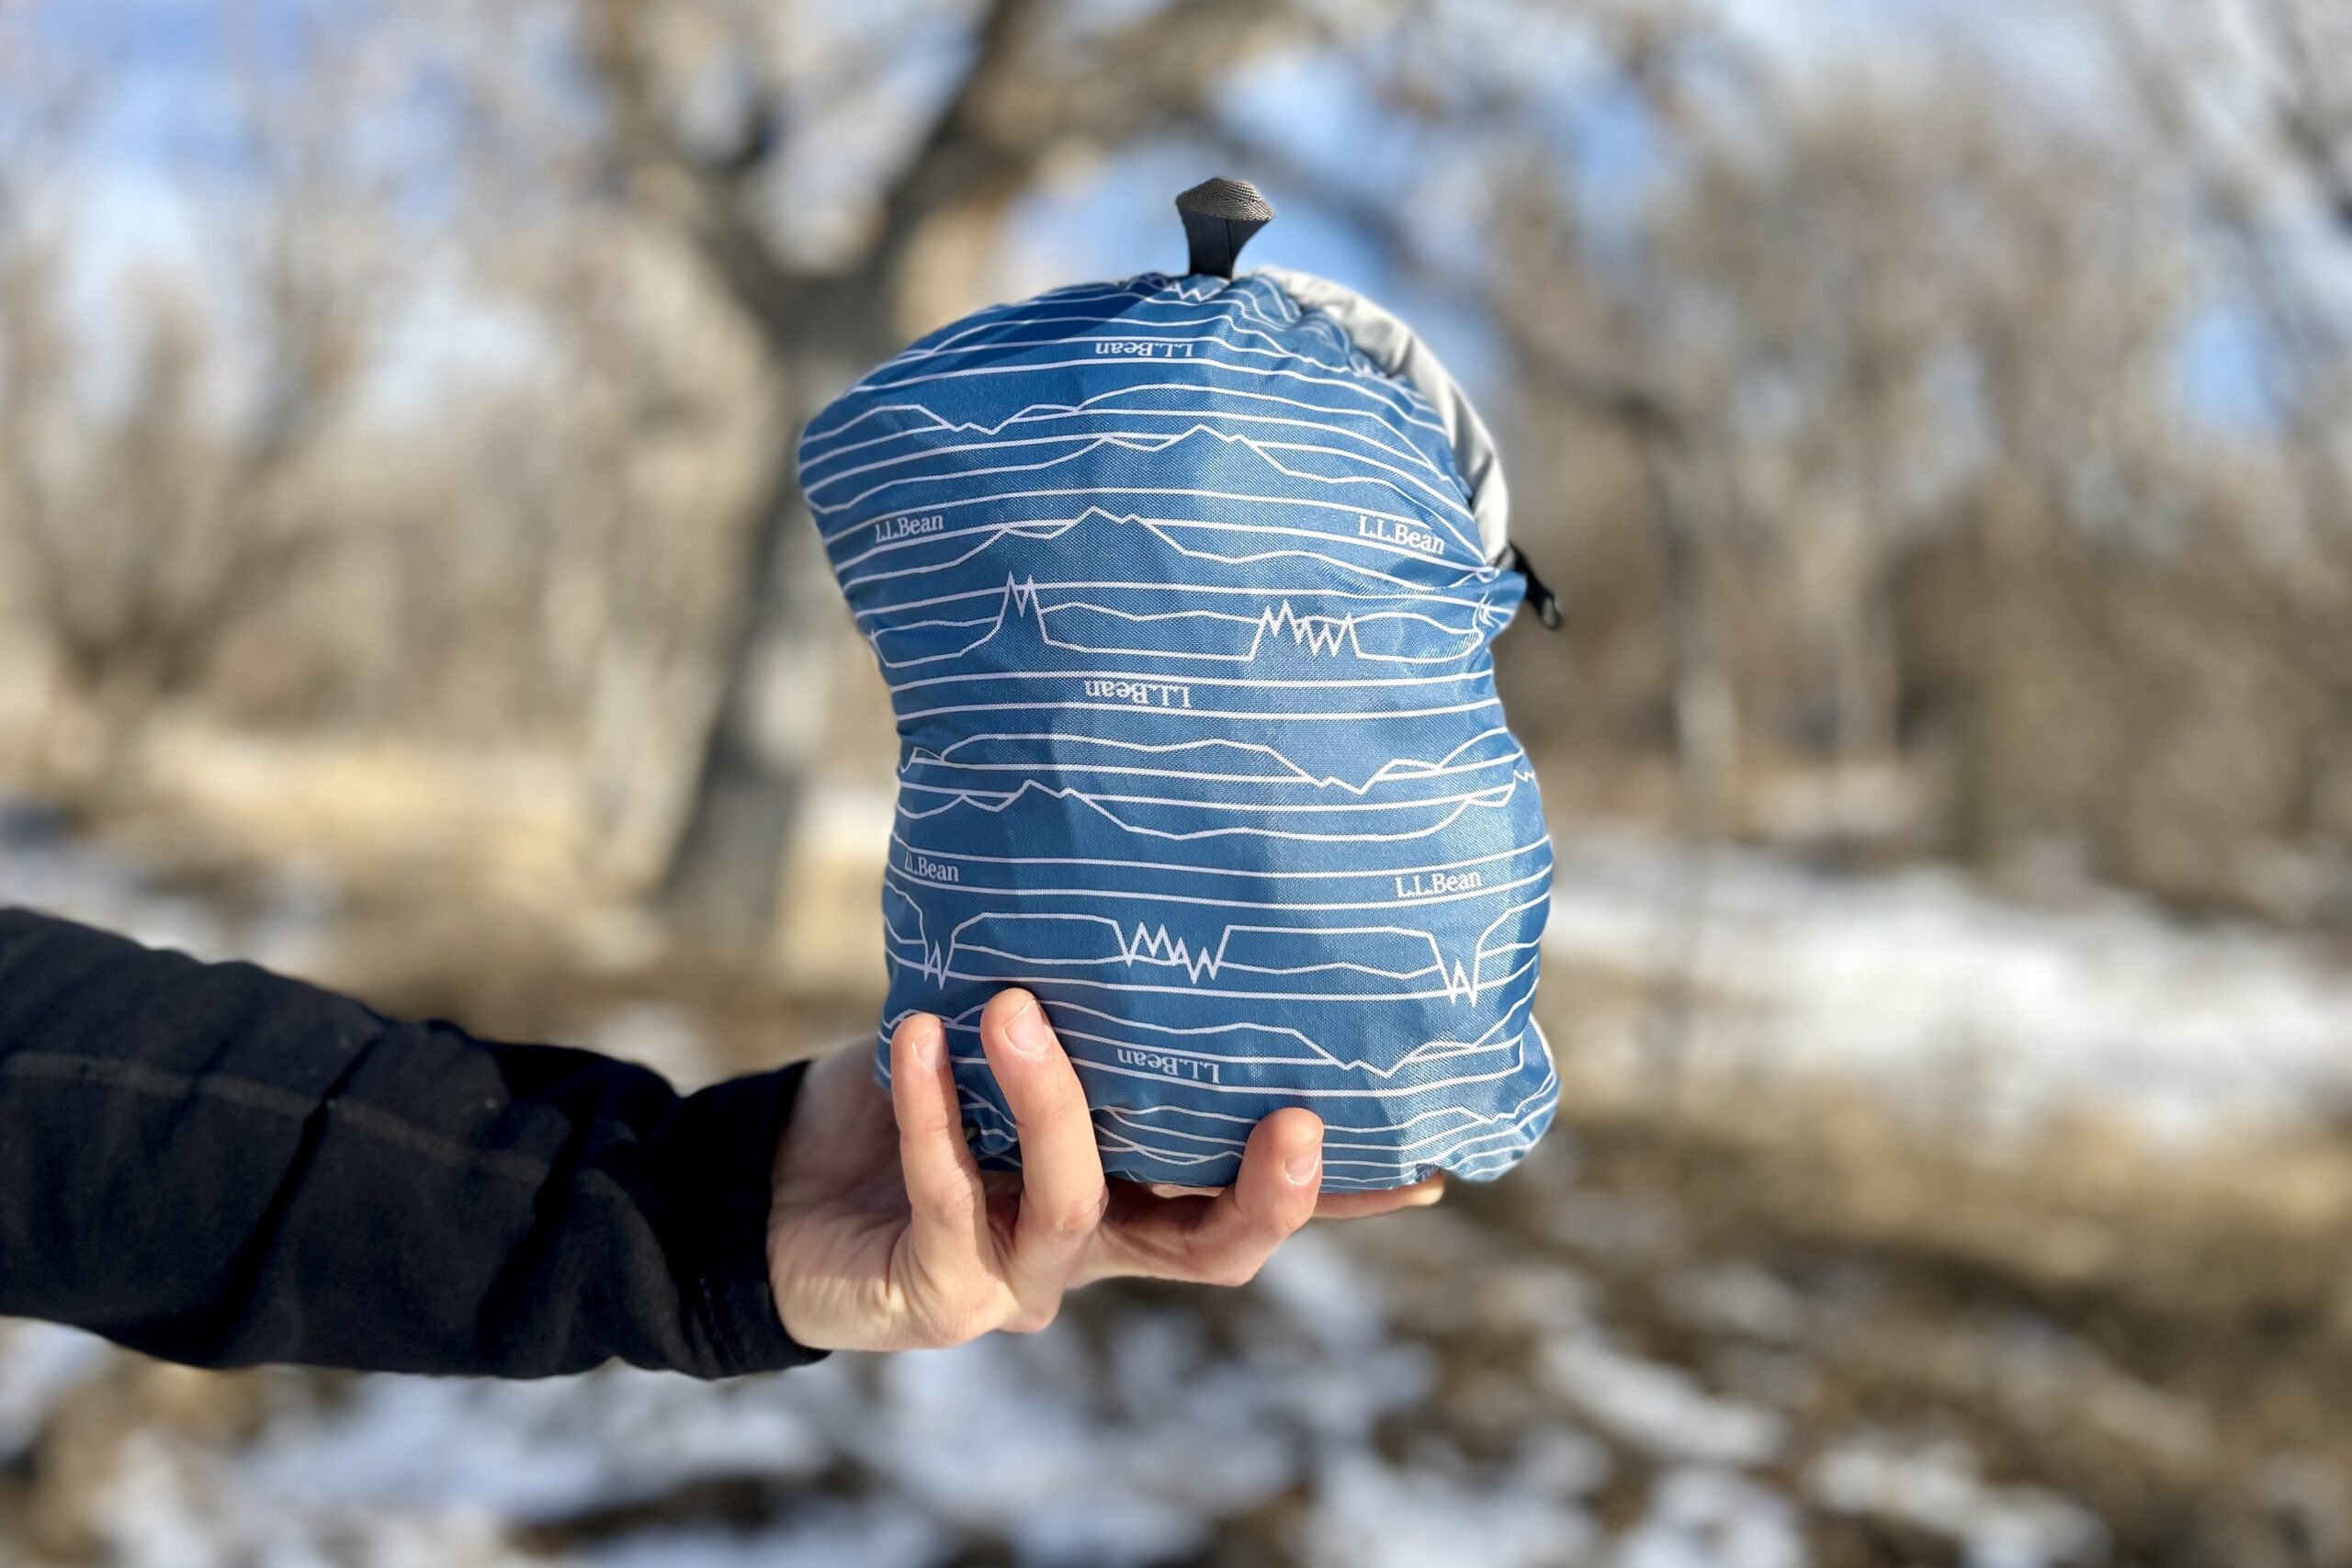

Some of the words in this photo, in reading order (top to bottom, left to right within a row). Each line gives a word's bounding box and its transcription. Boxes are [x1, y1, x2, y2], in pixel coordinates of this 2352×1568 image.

[1095, 342, 1194, 357] L.L.Bean
[875, 514, 944, 543] L.L.Bean
[1359, 514, 1444, 556] L.L.Bean
[1084, 680, 1192, 707] L.L.Bean
[1395, 871, 1482, 898] L.L.Bean
[1116, 1048, 1220, 1084] L.L.Bean
